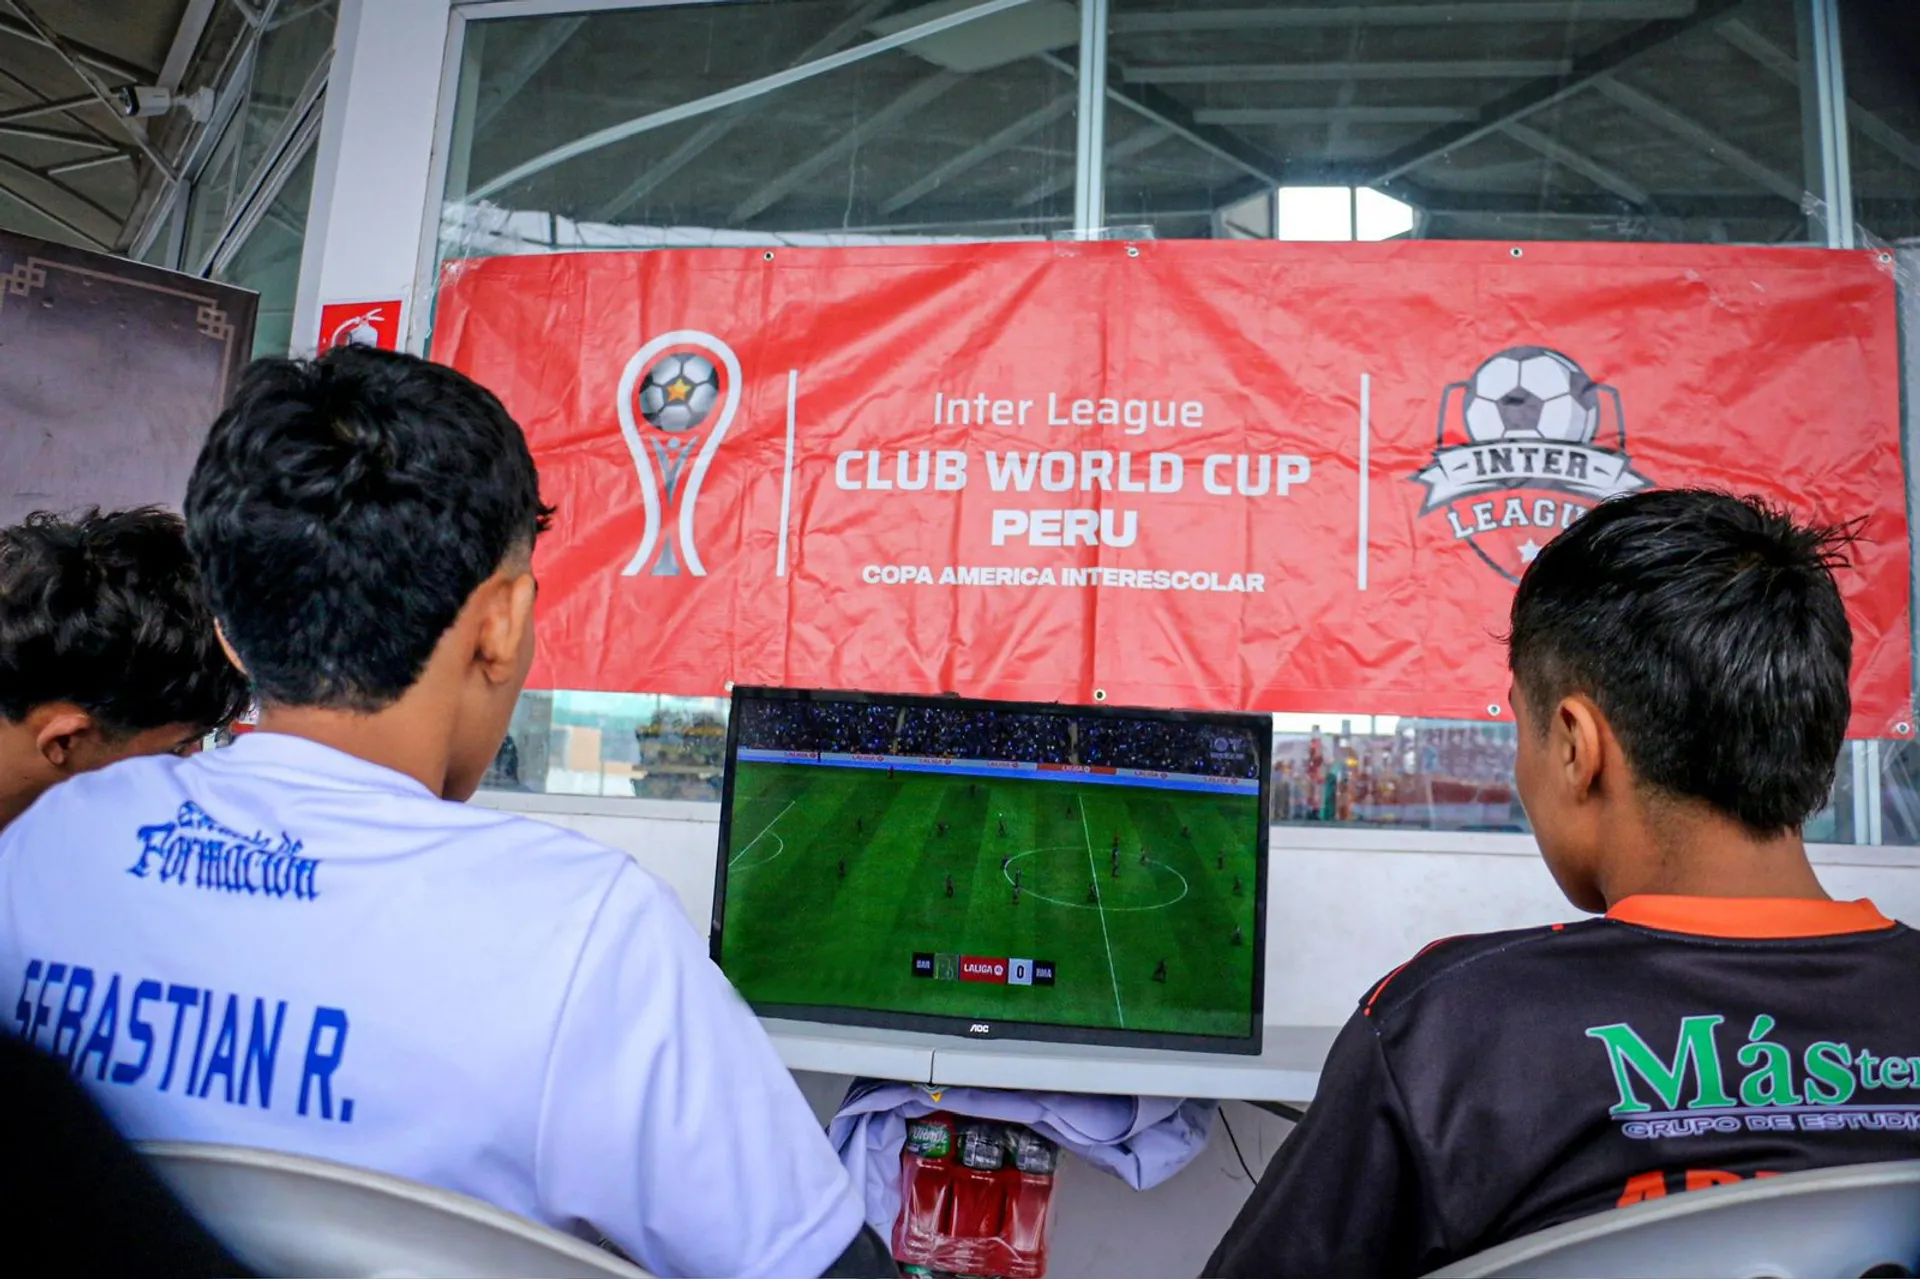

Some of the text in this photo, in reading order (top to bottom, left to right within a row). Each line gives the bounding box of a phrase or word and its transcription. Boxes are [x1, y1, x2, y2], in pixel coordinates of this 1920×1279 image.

[934, 392, 1204, 435] Inter League
[835, 450, 1311, 497] CLUB WORLD CUP
[1472, 448, 1589, 480] INTER
[991, 508, 1138, 548] PERU
[1448, 497, 1588, 539] LEAGU
[862, 564, 1265, 593] COPA AMERICA INTERESCOLAR
[963, 963, 993, 974] LALIGA
[1016, 964, 1025, 979] 0
[970, 1024, 990, 1034] AOC
[296, 1005, 355, 1123] R.
[1621, 1111, 1920, 1140] GRUPO DE ESTUDI
